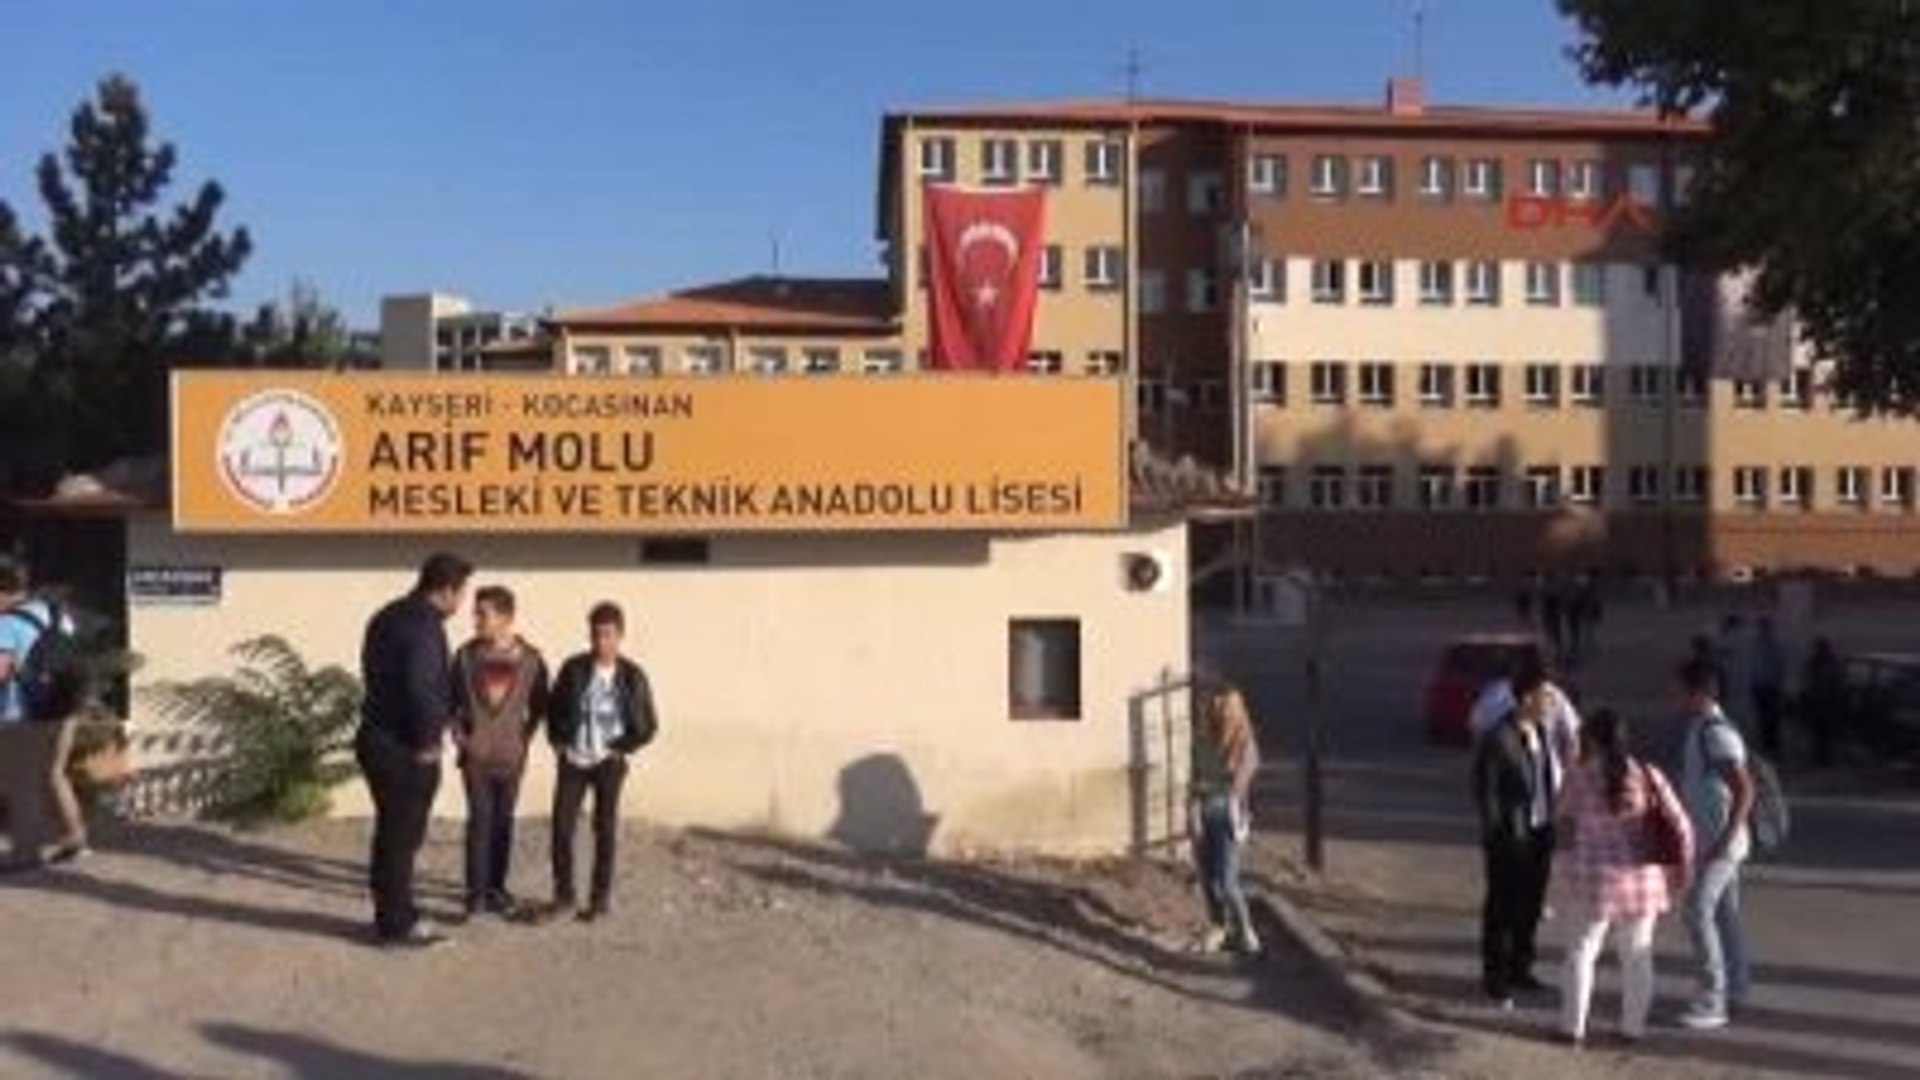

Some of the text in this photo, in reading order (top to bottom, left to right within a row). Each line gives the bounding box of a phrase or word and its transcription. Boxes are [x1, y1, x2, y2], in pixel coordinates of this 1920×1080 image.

[366, 387, 491, 417] KAYSERİ
[368, 420, 654, 472] ARİF MOLU
[368, 477, 542, 516] MESLEKİ
[552, 484, 601, 515] VE
[615, 475, 759, 516] TEKNİK
[769, 483, 953, 515] ANADOLU
[968, 474, 1082, 514] LİSESİ
